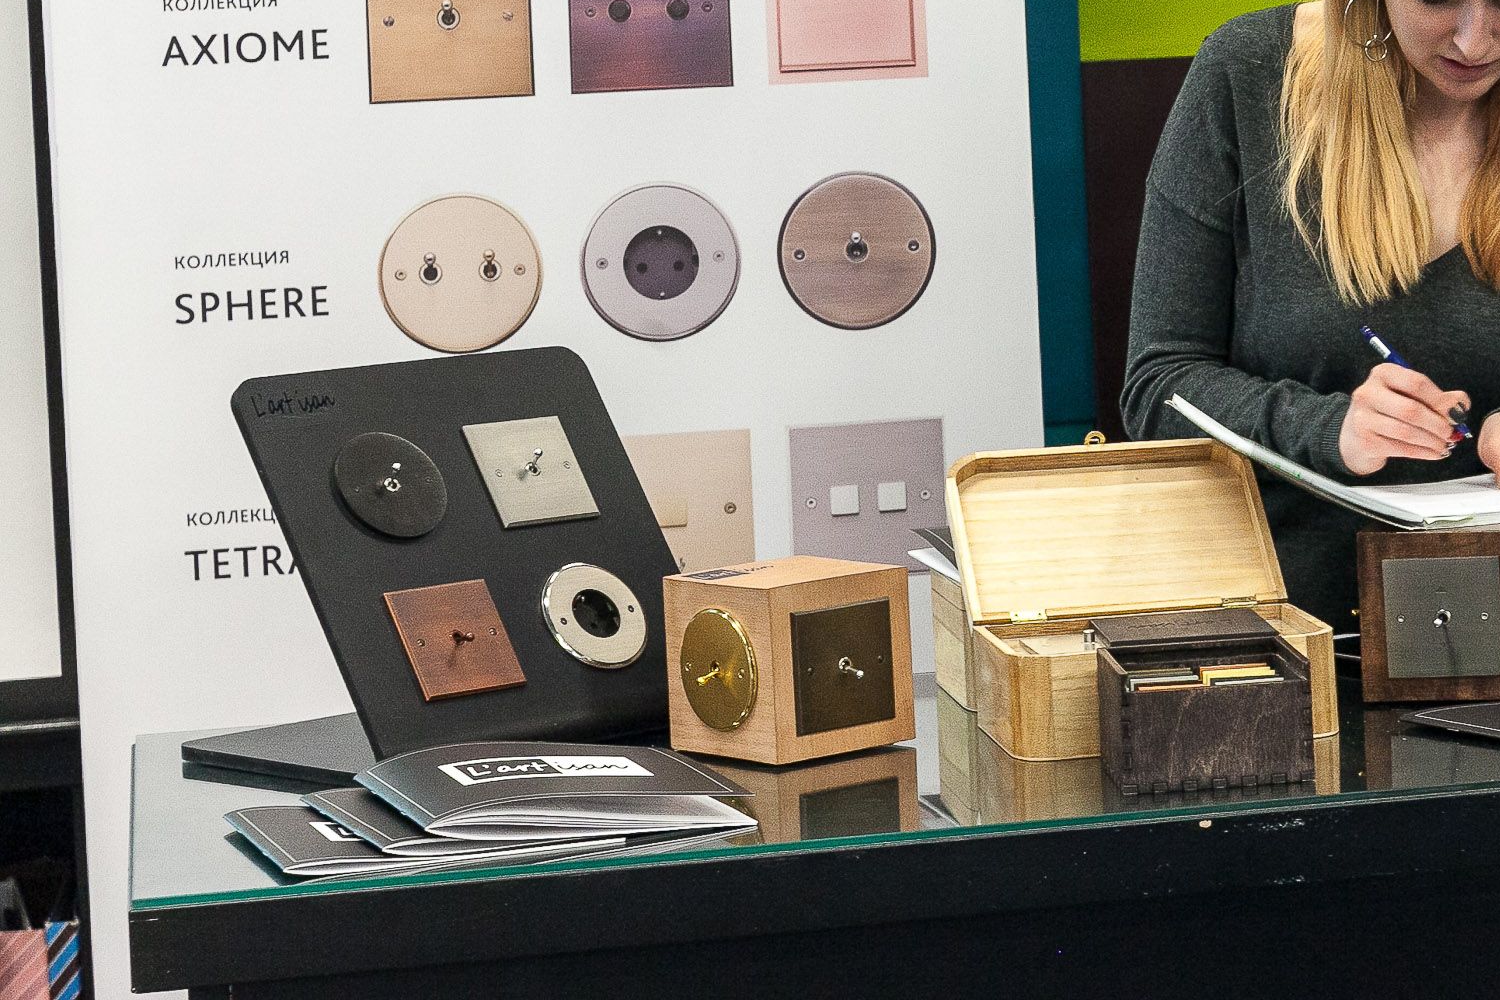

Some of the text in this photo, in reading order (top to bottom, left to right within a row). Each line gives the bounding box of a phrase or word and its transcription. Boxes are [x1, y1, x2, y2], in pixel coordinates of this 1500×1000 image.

[162, 28, 330, 67] AXIOME
[174, 249, 291, 270] КОЛЛЕКЦИЯ
[175, 285, 330, 325] SPHERE
[186, 508, 276, 526] КОЛЛЕКЦ
